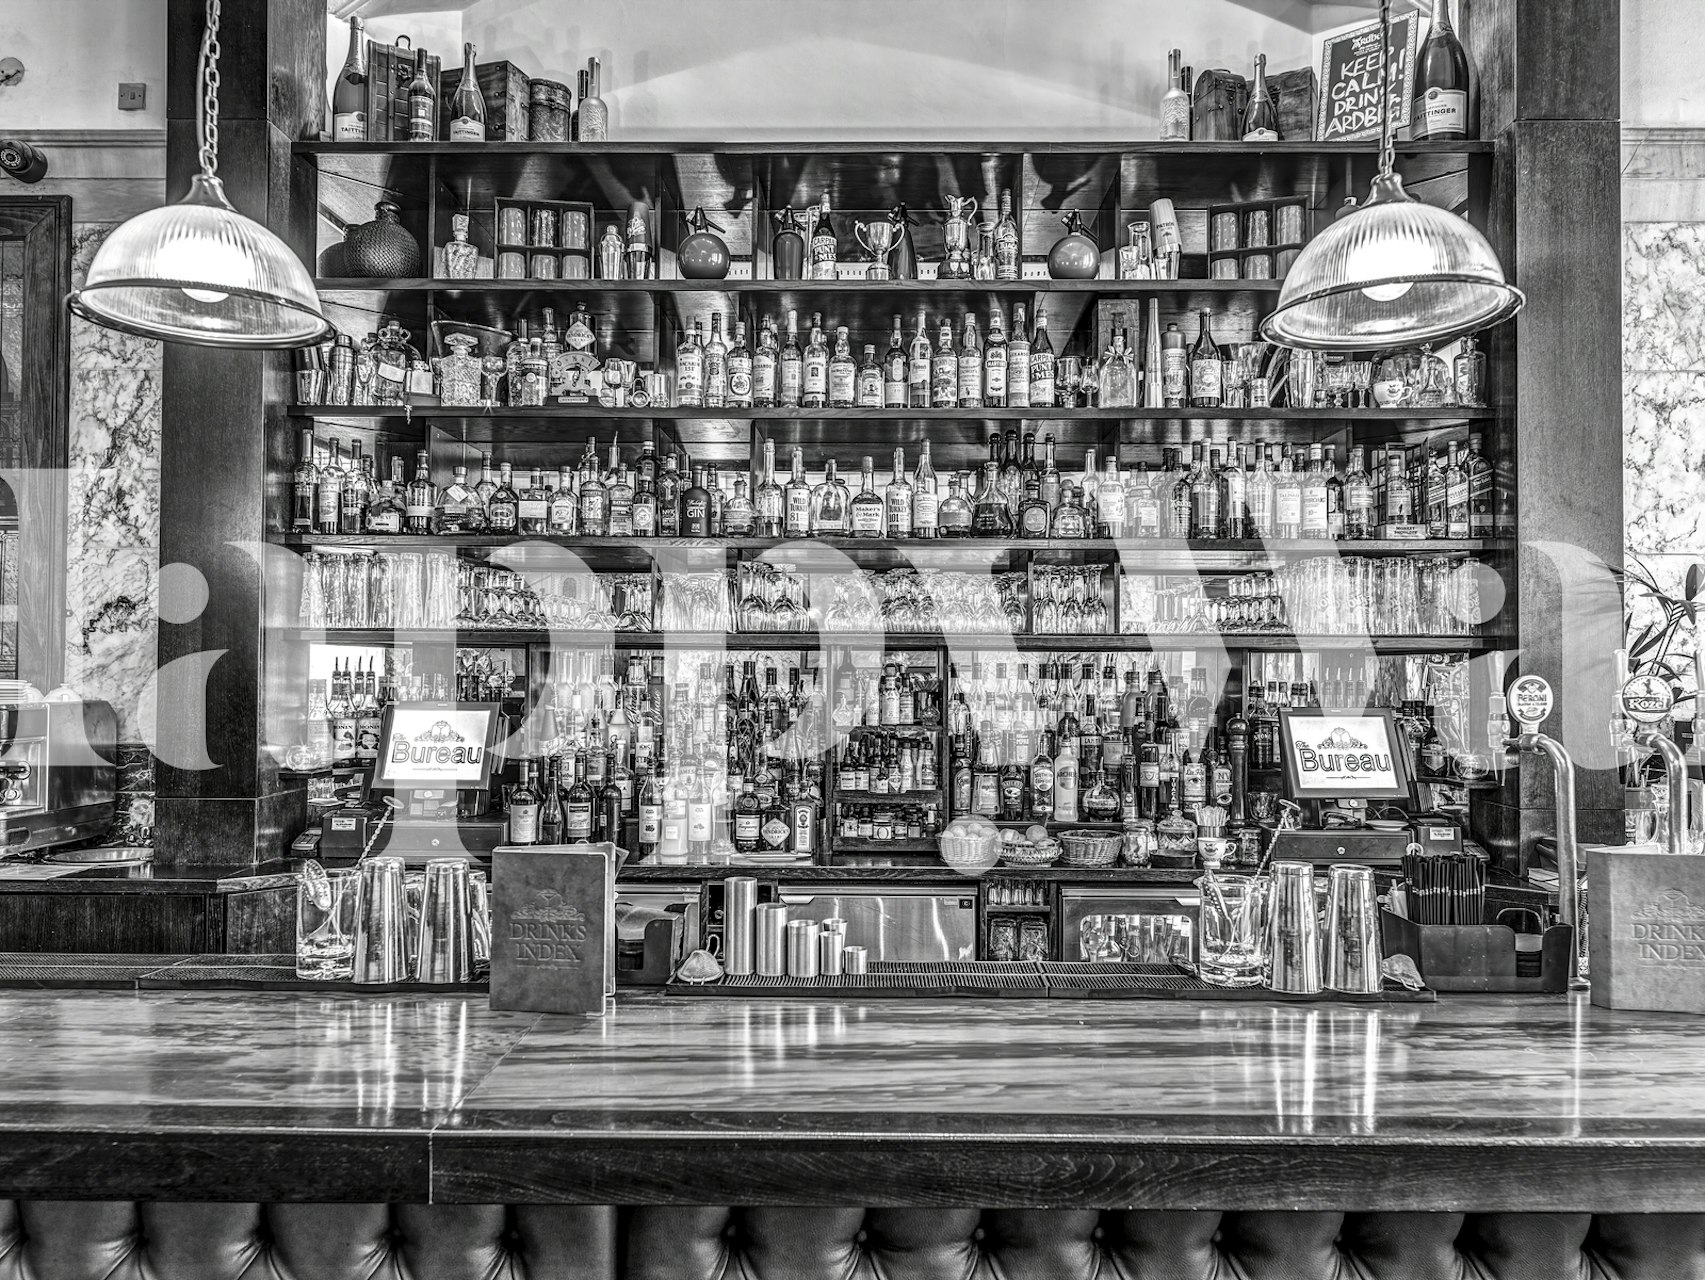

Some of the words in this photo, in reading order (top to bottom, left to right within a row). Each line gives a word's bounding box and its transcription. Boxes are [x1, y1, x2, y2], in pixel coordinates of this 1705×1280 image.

[792, 496, 806, 505] WILD
[890, 498, 905, 506] WILD
[686, 510, 705, 518] GIN
[789, 513, 799, 522] 81
[888, 513, 899, 523] 101
[1517, 693, 1547, 702] PERONI
[391, 740, 483, 764] Bureau
[1299, 748, 1391, 772] Bureau
[508, 922, 587, 942] DRINKS
[515, 943, 582, 963] INDEX
